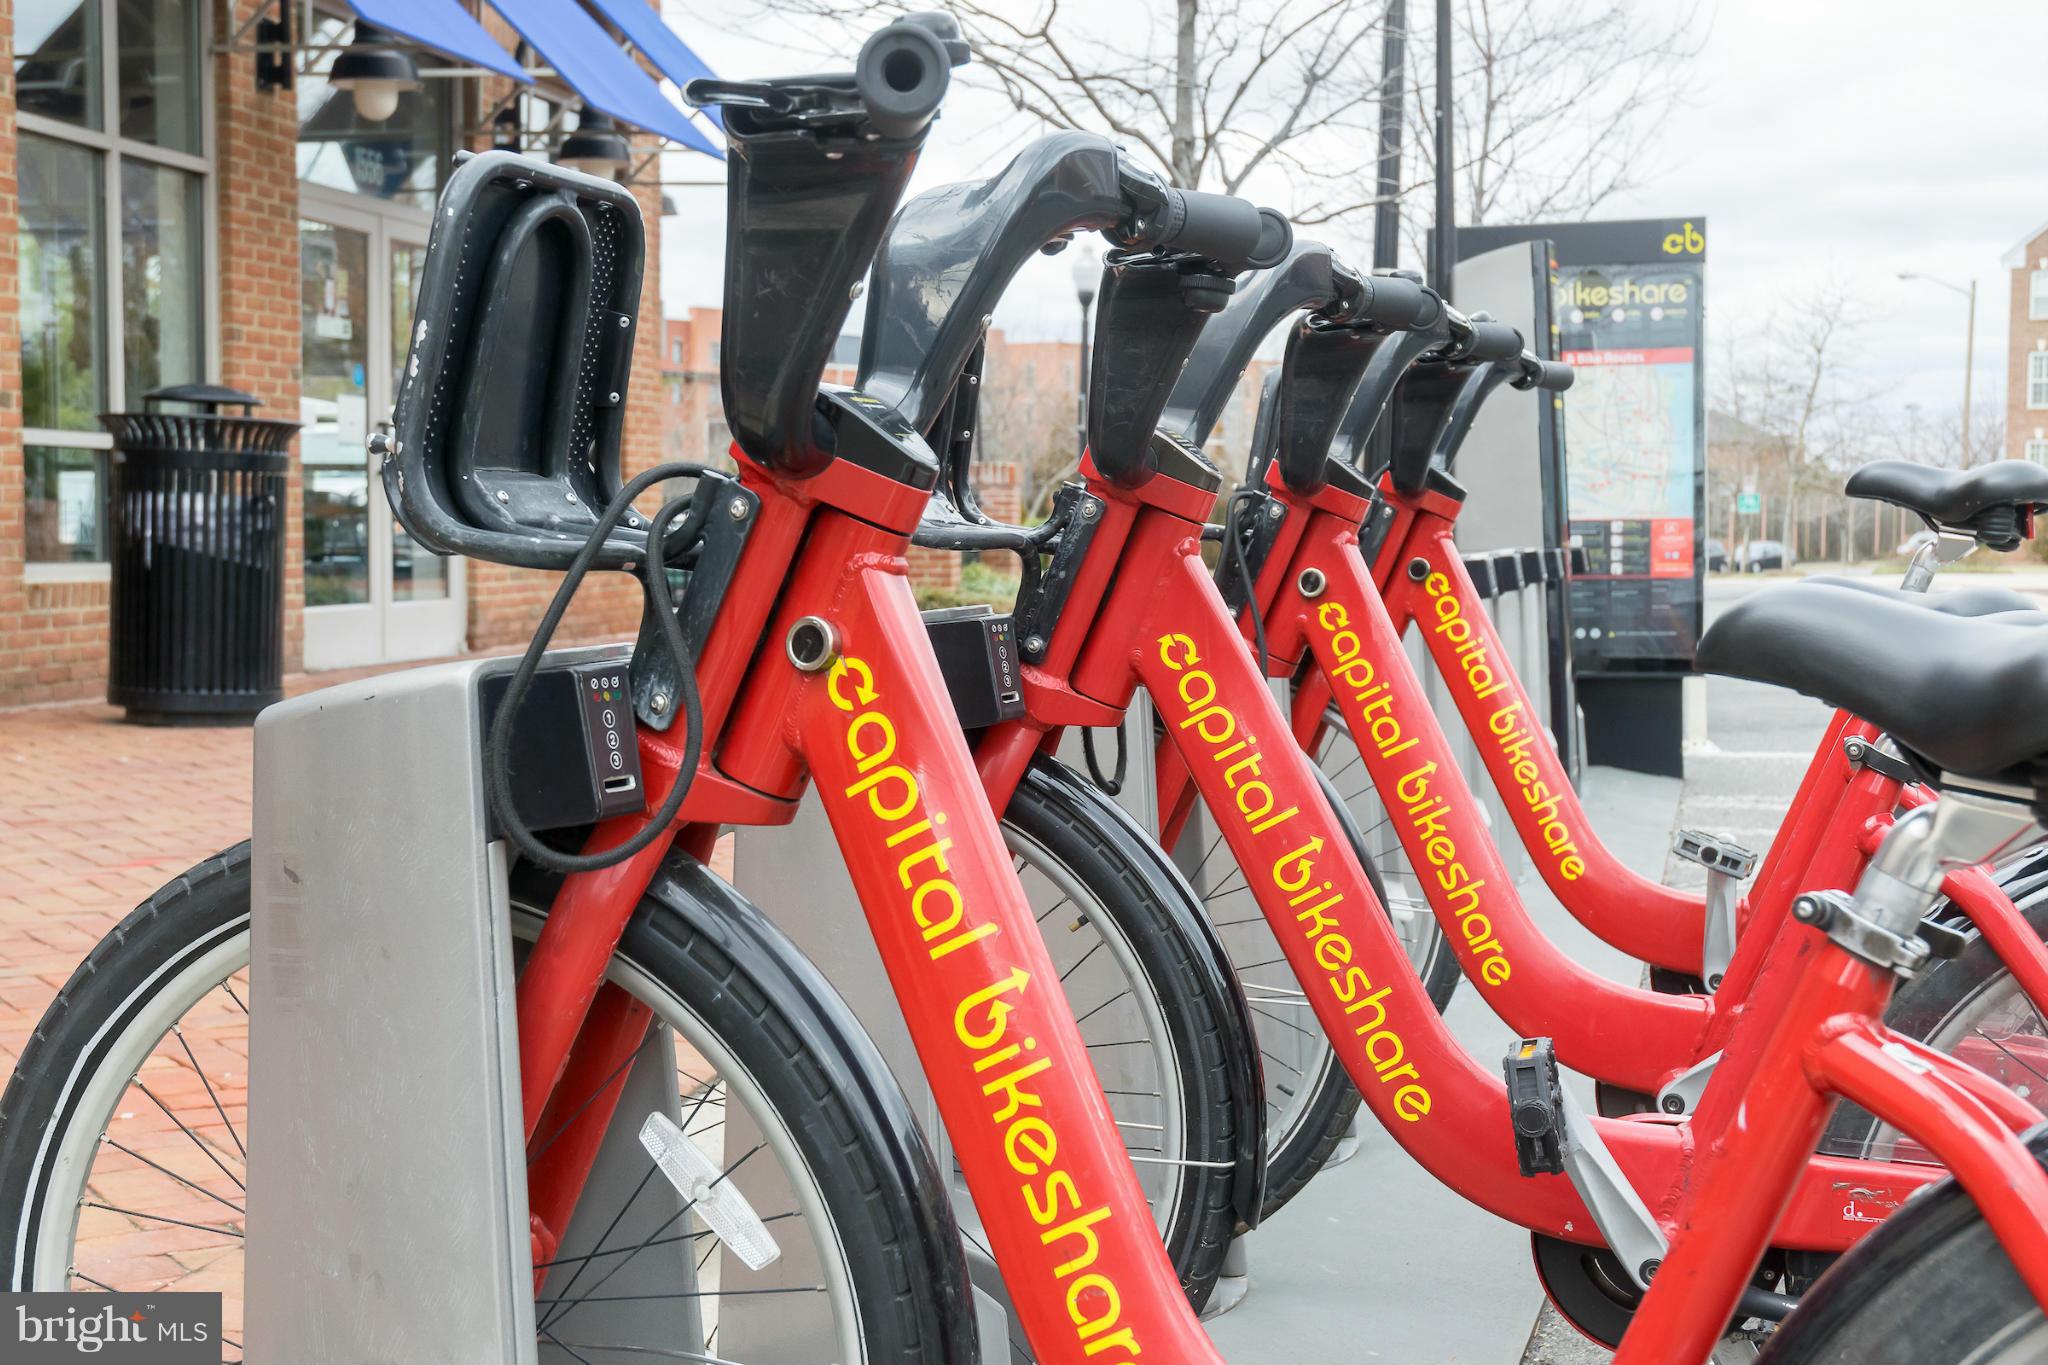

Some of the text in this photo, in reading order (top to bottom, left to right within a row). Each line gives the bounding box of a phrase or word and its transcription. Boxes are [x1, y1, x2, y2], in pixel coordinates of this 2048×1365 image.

[1157, 633, 1432, 1122] capital bikeshare
[1318, 602, 1511, 986] capital bikeshare
[1425, 571, 1586, 881] capital bikeshare
[827, 654, 1143, 1365] capital bikeshar
